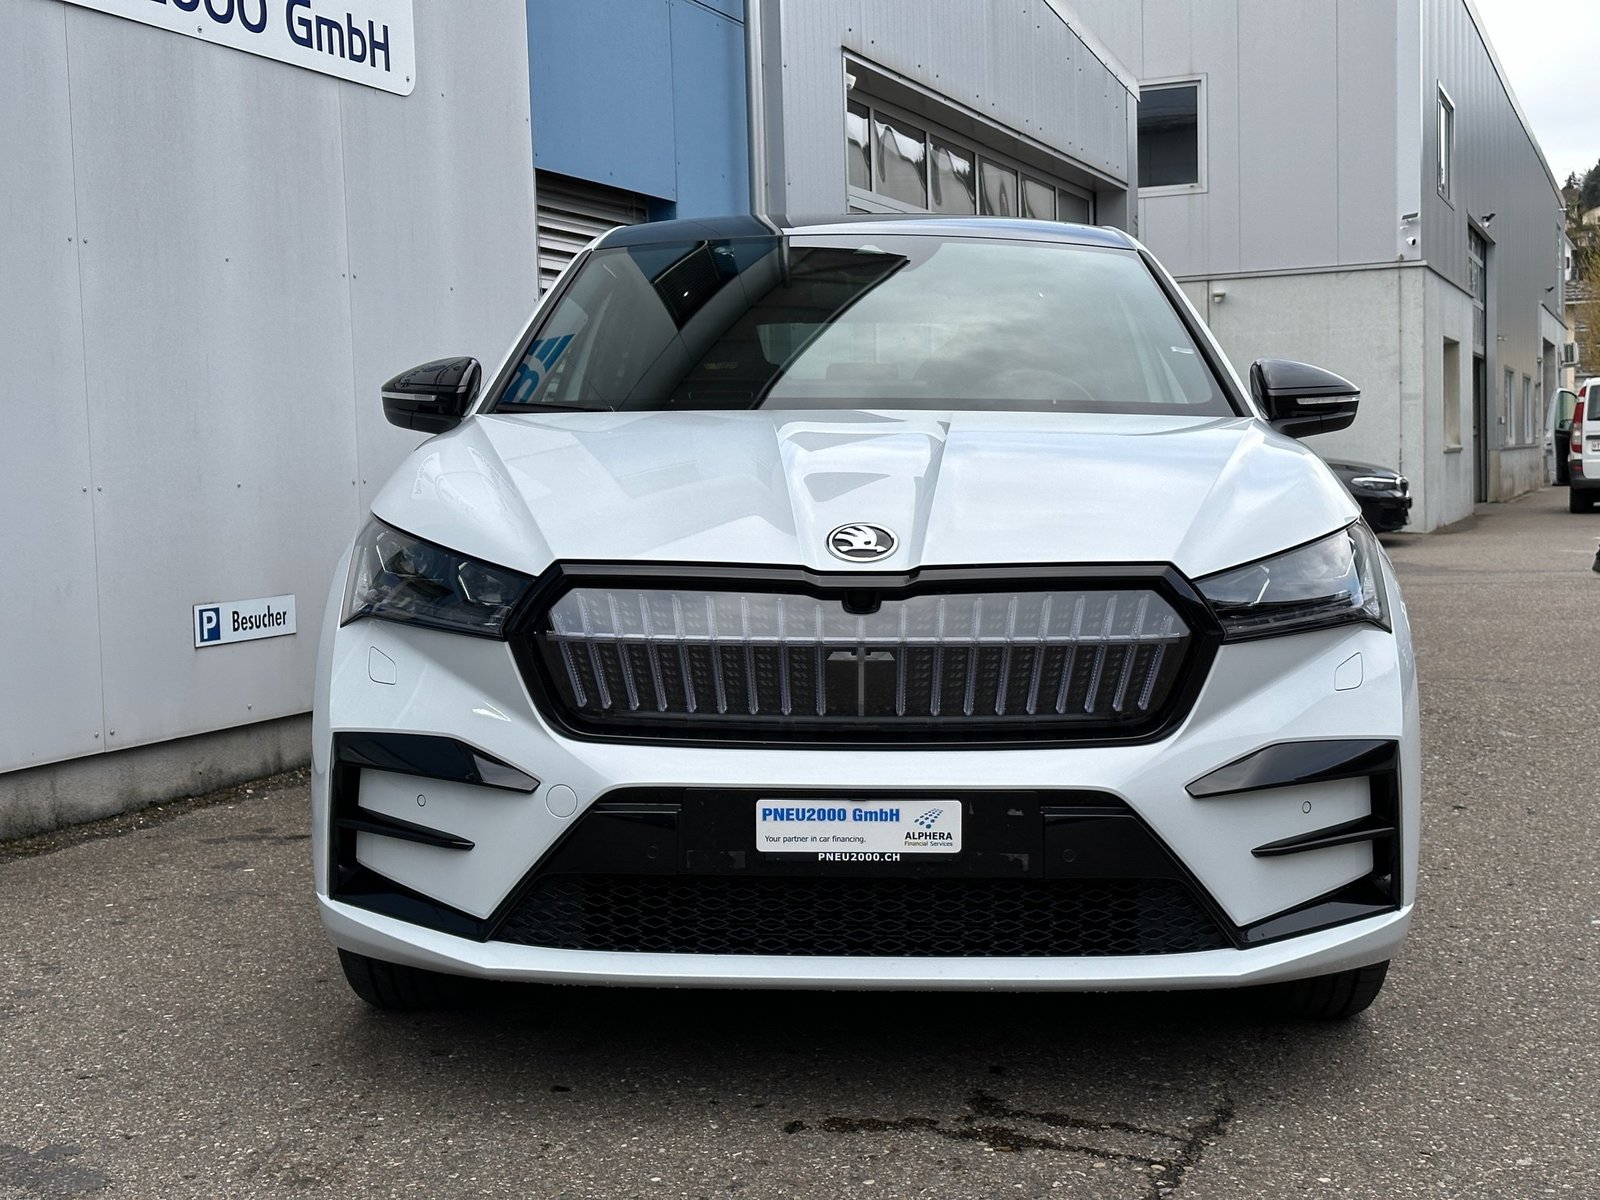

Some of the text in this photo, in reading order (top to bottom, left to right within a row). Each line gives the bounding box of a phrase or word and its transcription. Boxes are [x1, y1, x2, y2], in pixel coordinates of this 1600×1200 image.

[286, 0, 391, 73] GmbH
[202, 604, 288, 640] P Besucher
[761, 807, 900, 822] PNEU2000 GmbH
[764, 835, 867, 845] Your partner in car financing.
[904, 831, 954, 841] ALPHERA
[904, 840, 953, 848] Financial Services
[818, 852, 900, 862] PNEU2000.CH
